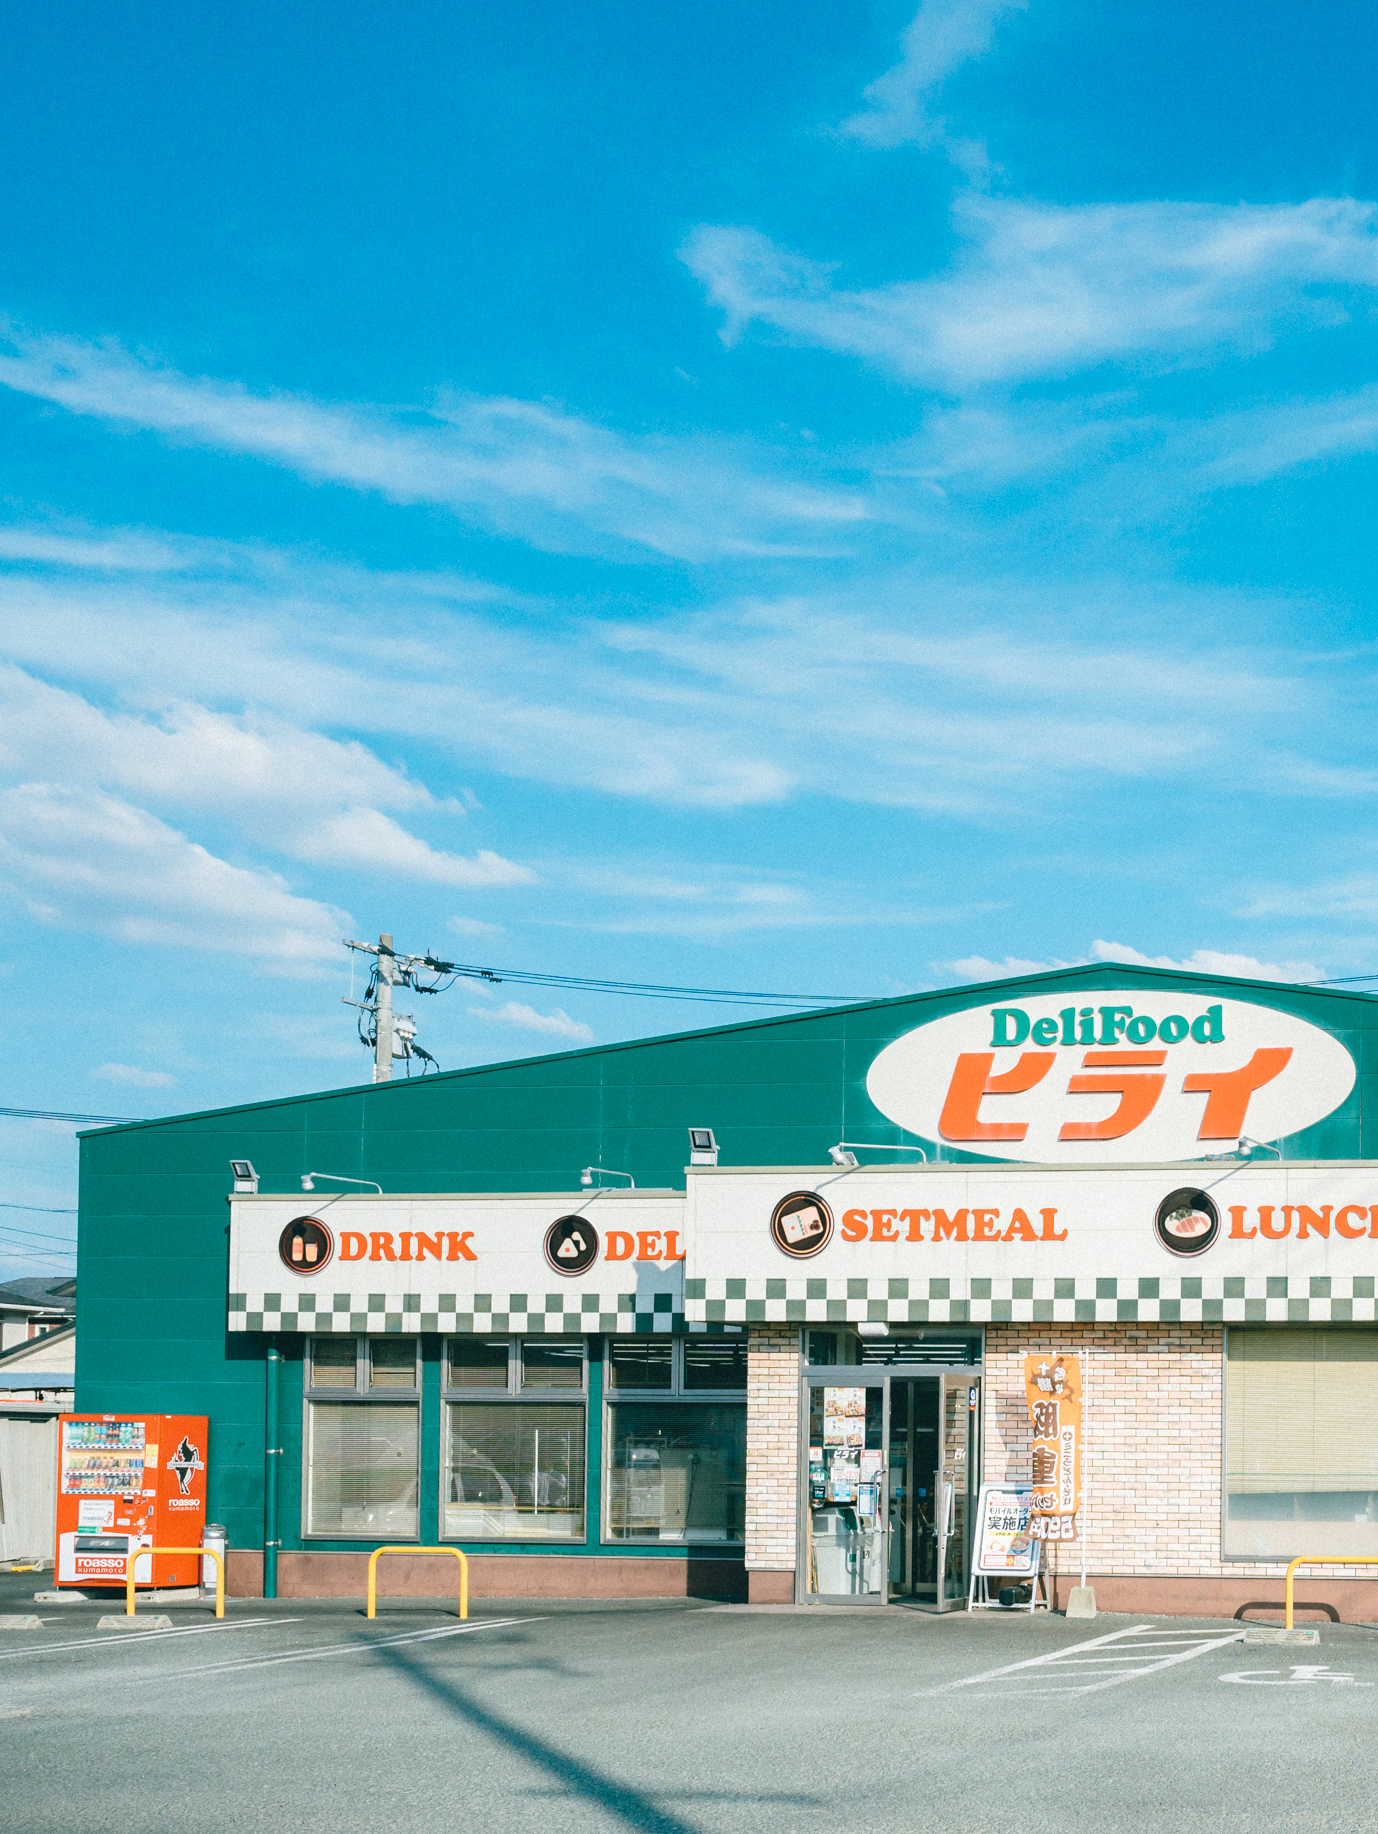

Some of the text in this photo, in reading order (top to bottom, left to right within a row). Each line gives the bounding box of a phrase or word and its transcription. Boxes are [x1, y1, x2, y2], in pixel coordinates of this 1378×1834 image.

[989, 1005, 1225, 1048] DeliFood
[937, 1046, 1294, 1142] ヒライ
[840, 1207, 1069, 1243] SETMEAL
[338, 1231, 479, 1262] DRINK
[833, 1450, 858, 1459] ヒライ
[168, 1498, 201, 1507] roasso
[78, 1558, 124, 1568] roasso
